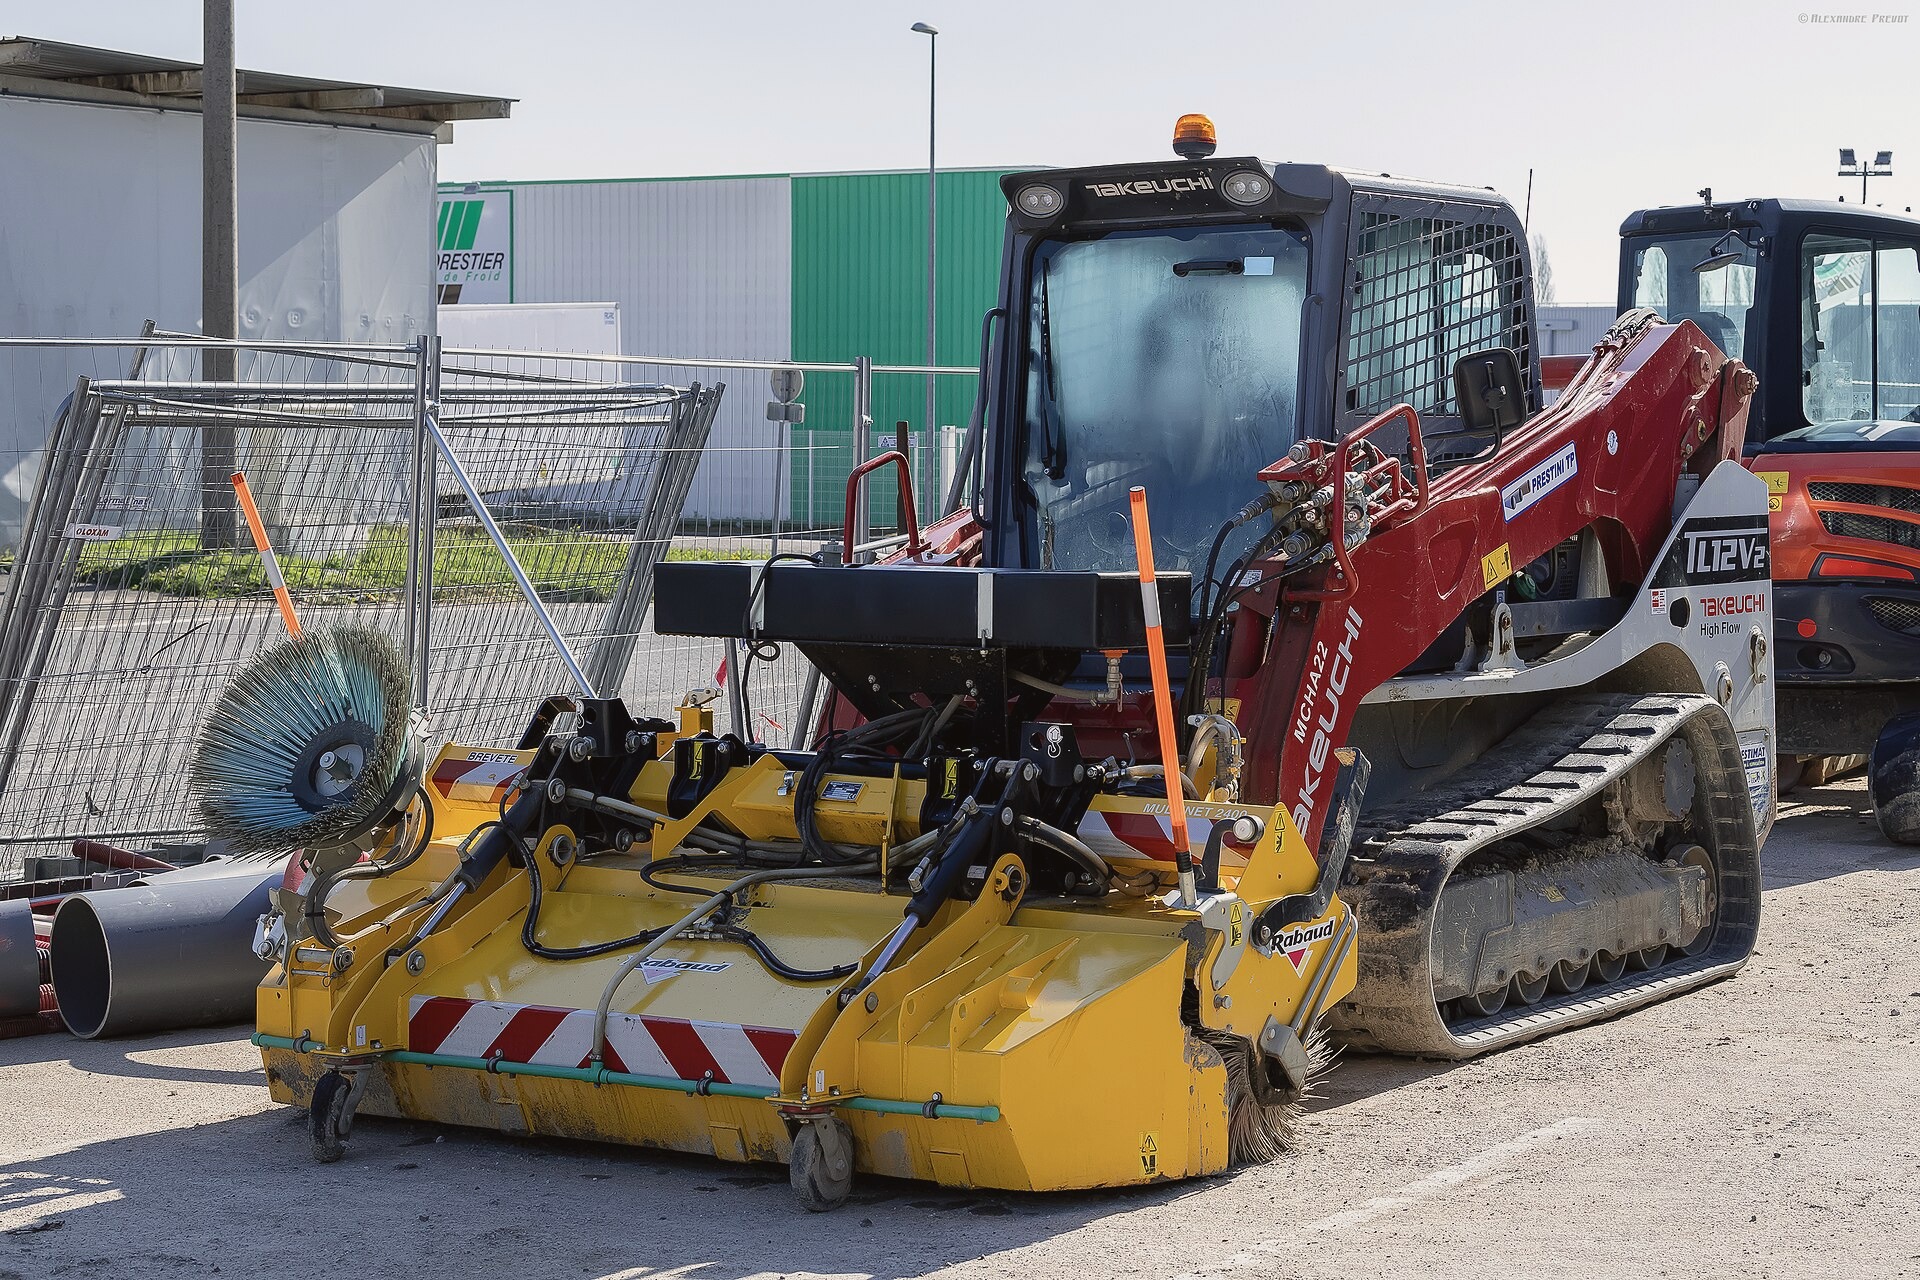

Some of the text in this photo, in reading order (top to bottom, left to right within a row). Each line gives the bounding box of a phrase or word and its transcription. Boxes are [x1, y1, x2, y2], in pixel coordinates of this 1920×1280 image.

[1085, 176, 1214, 197] TAKEUCHI
[437, 252, 505, 270] RESTIER
[465, 271, 501, 282] Froid
[1531, 451, 1575, 494] PRESTINI TP
[1700, 593, 1765, 617] TAKEUCHI
[1700, 621, 1741, 638] High Flow
[1293, 640, 1328, 744] MCHA22
[1293, 605, 1363, 841] AKEUCHI
[467, 751, 518, 764] BREVETE
[1143, 803, 1214, 817] MULNET
[1271, 920, 1335, 954] Rabaud
[634, 958, 730, 973] abaud
